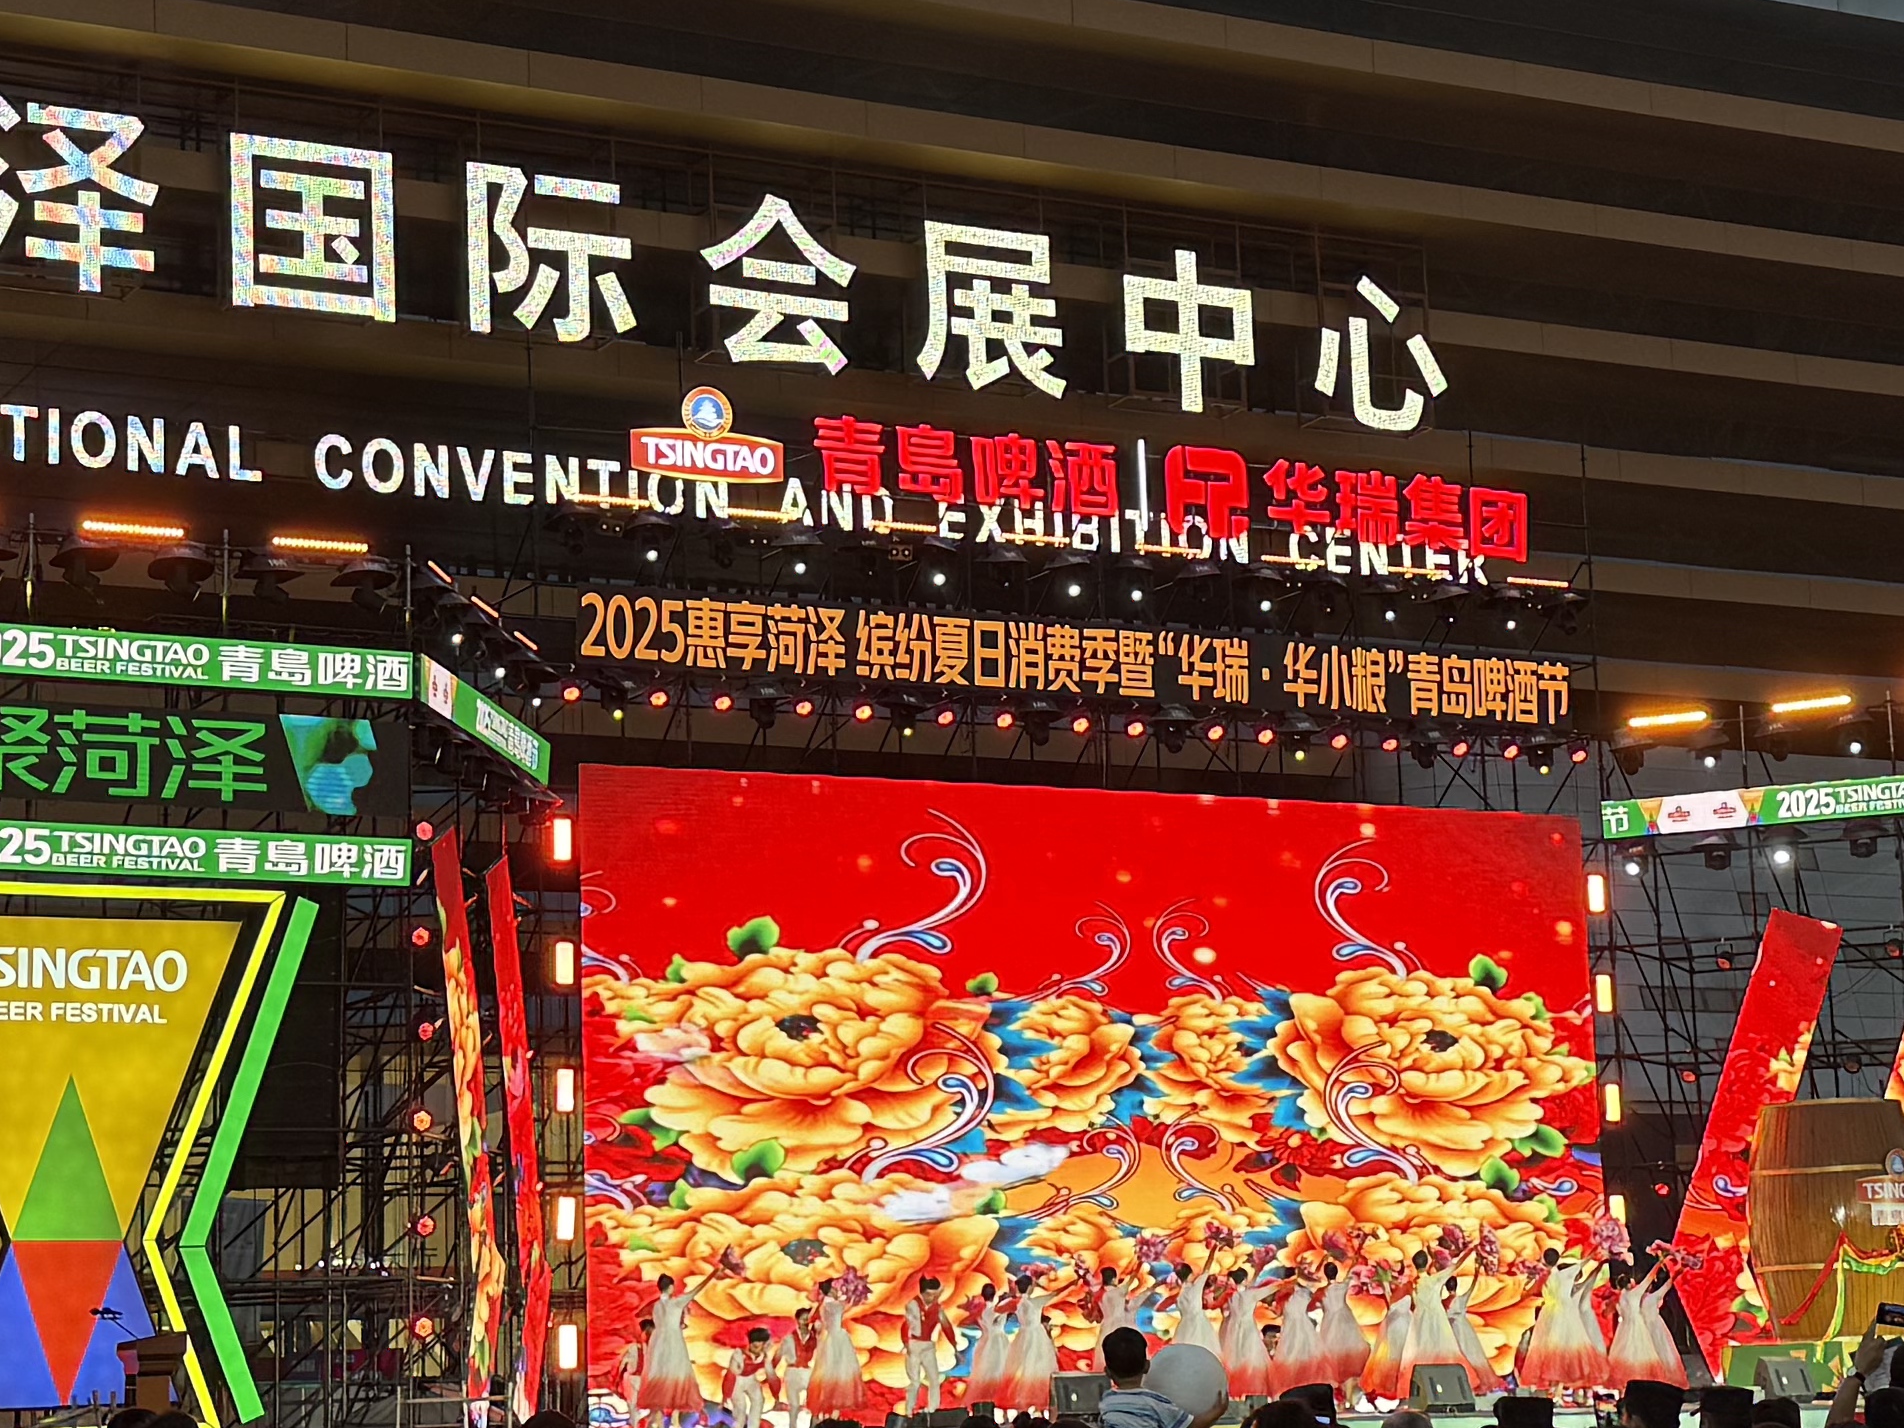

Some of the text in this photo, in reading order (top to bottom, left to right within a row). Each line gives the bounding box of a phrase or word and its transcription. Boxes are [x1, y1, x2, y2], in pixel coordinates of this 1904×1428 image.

[640, 415, 1528, 563] TSINGTAO 青島啤酒 华瑞集团
[580, 591, 847, 676] 2025惠享菏泽
[55, 657, 210, 681] BEER FESTIVAL
[56, 633, 210, 666] TSINGTAO
[217, 644, 409, 693] 青島啤酒
[1775, 787, 1836, 820] 2025
[51, 853, 206, 873] BEER FESTIVAL
[52, 832, 207, 859] TSINGTAO
[214, 837, 407, 881] 青島啤酒
[51, 1002, 168, 1025] FESTIVAL
